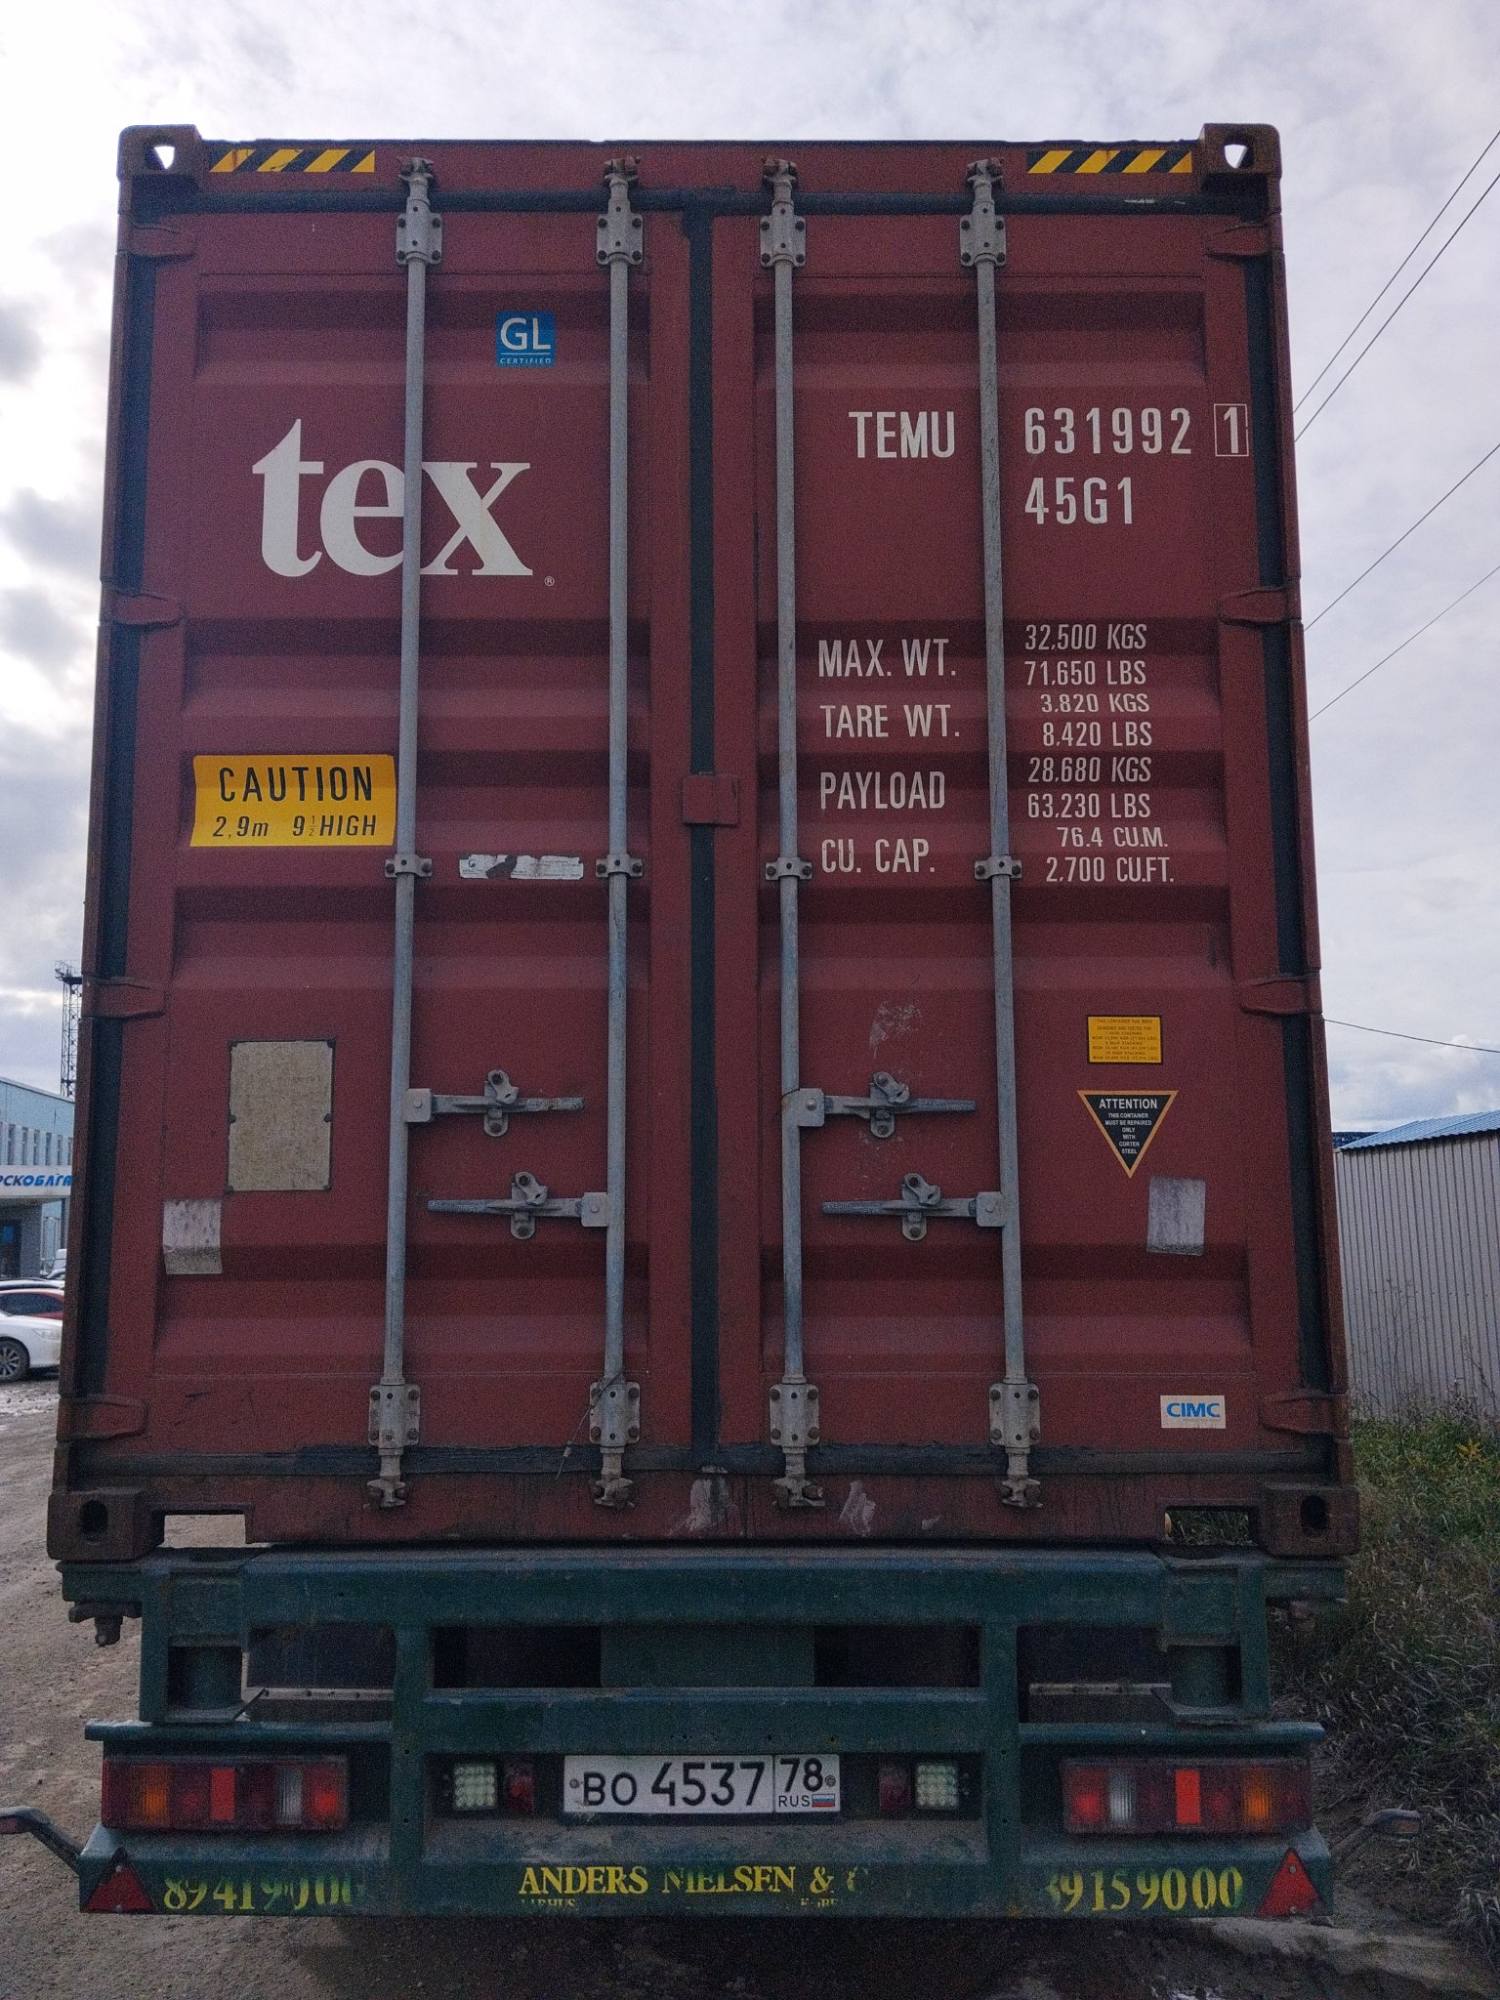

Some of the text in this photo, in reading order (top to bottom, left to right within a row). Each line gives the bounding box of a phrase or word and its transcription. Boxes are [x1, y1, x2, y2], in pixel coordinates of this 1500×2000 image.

[501, 317, 551, 351] GL
[849, 411, 955, 458] TEMU
[1025, 407, 1192, 454] 631992
[252, 418, 533, 577] tex
[1025, 477, 1133, 524] 45G1
[1107, 624, 1147, 649] KGS
[819, 638, 957, 677] MAX. WT.
[1107, 660, 1146, 685] LBS
[1109, 693, 1150, 712] KGS
[820, 705, 960, 738] TARE WT.
[1112, 721, 1152, 747] LBS
[1111, 757, 1152, 783] KGS
[219, 767, 372, 802] CAUTION
[820, 772, 946, 810] PAYLOAD
[1111, 793, 1151, 818] LBS
[1056, 827, 1168, 848] 76.4 CU.M.
[821, 838, 936, 872] CU. CAP.
[1116, 857, 1174, 883] CU.FT.
[1099, 1099, 1158, 1109] ATTENTION
[1167, 1402, 1220, 1417] CIMC
[651, 1761, 765, 1807] 4537
[780, 1758, 823, 1793] 78
[778, 1795, 810, 1807] RUS
[518, 1866, 649, 1895] ANDERS
